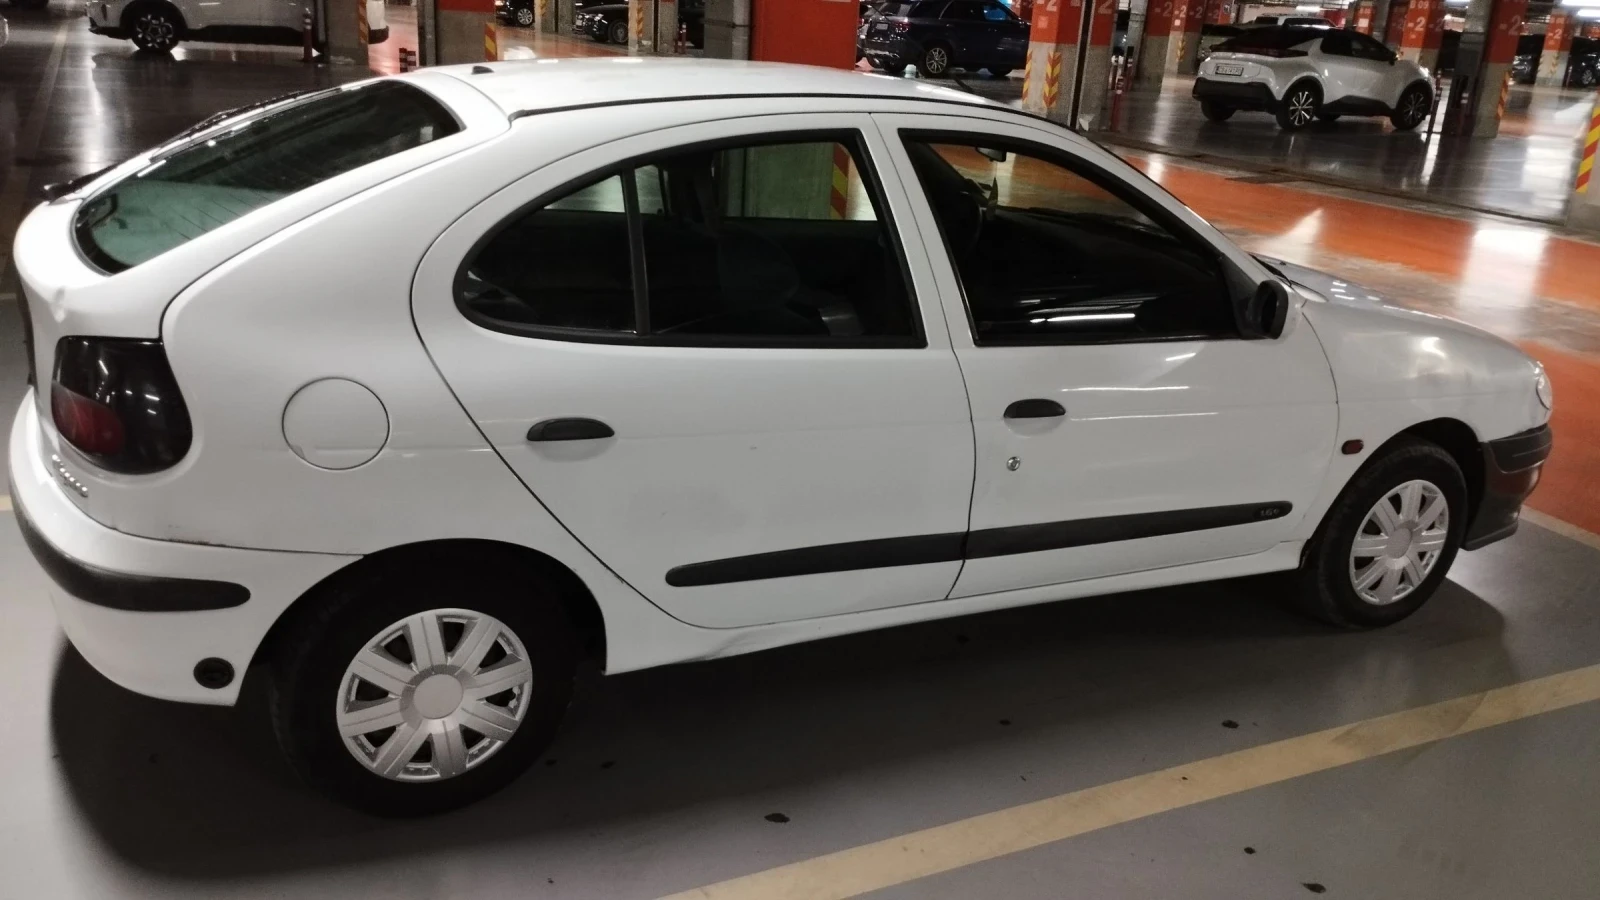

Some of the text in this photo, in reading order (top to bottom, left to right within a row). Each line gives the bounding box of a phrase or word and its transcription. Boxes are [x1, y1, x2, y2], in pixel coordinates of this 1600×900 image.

[1154, 1, 1173, 17] -2
[1174, 5, 1187, 18] -2
[1189, 6, 1203, 19] -2
[1408, 16, 1426, 32] -2
[1500, 15, 1521, 36] -2
[1548, 29, 1563, 40] -2
